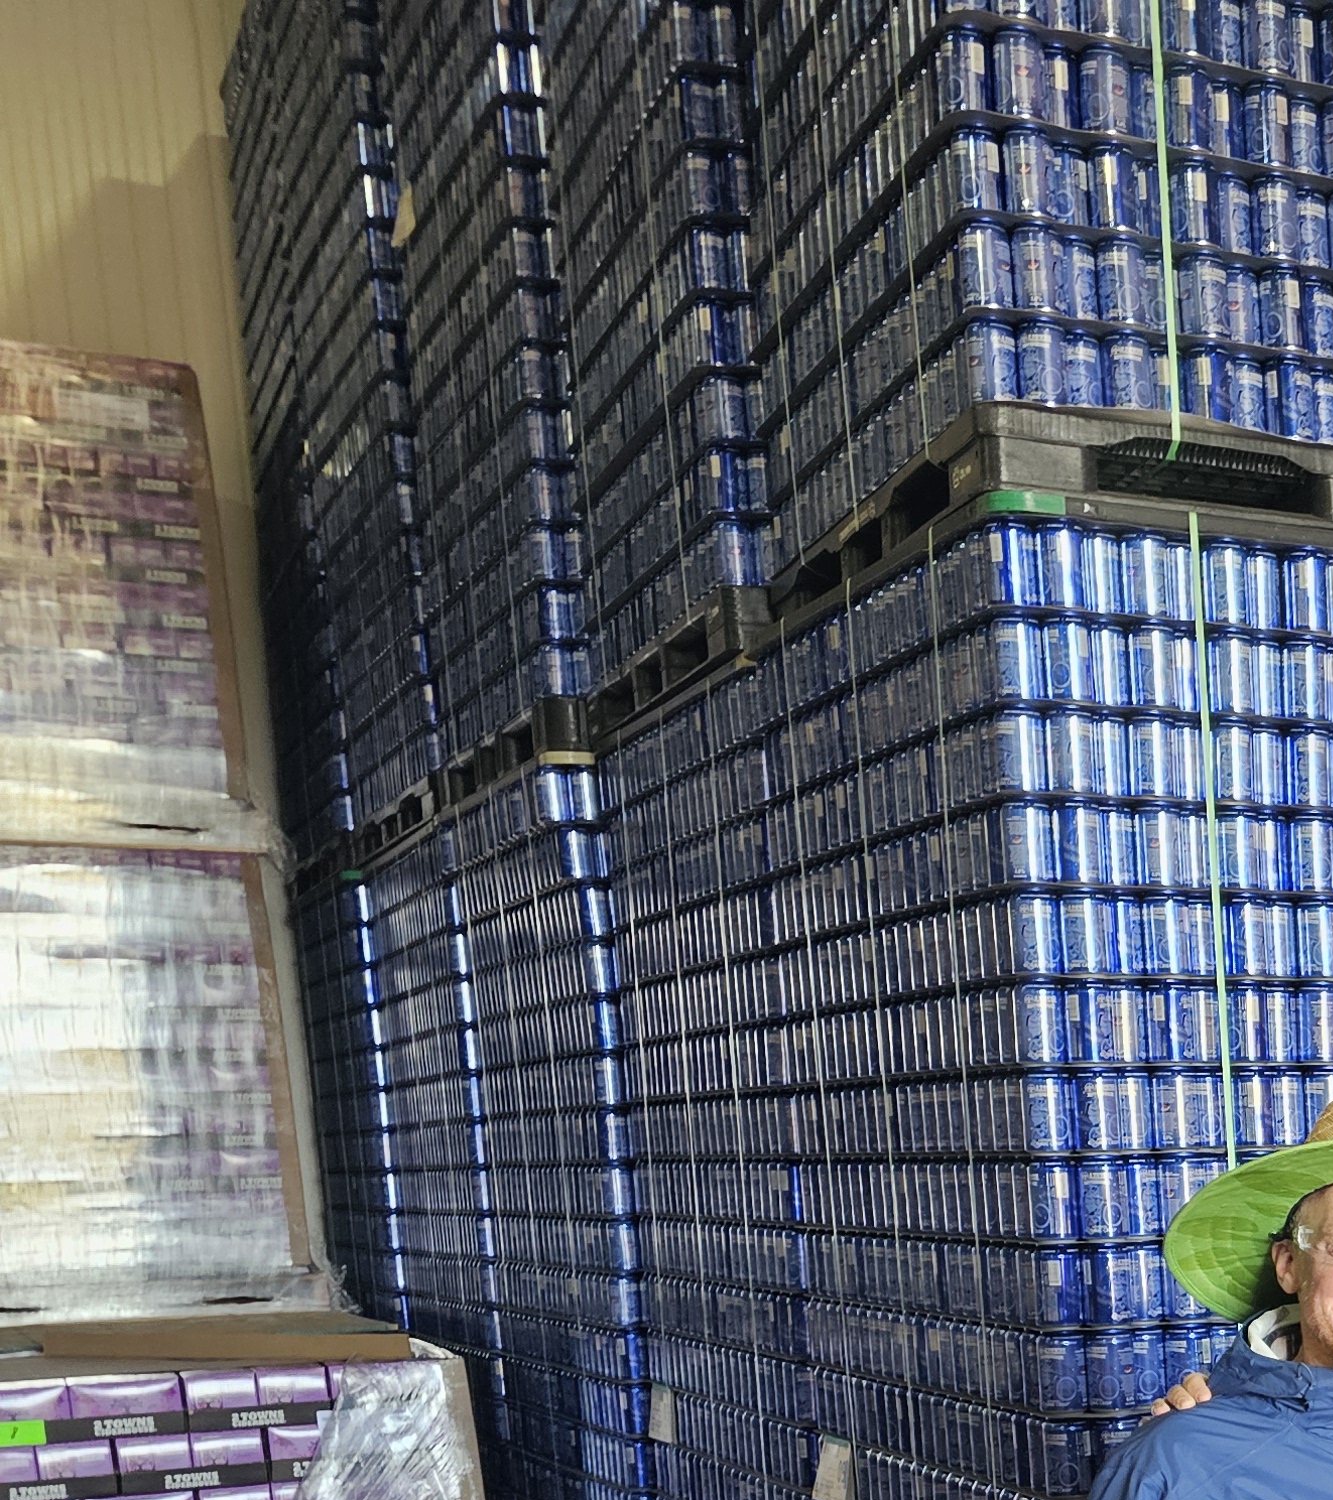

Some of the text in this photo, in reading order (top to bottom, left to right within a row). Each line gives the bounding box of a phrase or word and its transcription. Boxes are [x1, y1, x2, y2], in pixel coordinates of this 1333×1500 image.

[240, 1409, 285, 1420] TOWNS
[103, 1416, 155, 1428] TOWNS
[173, 1471, 219, 1482] TOWNS
